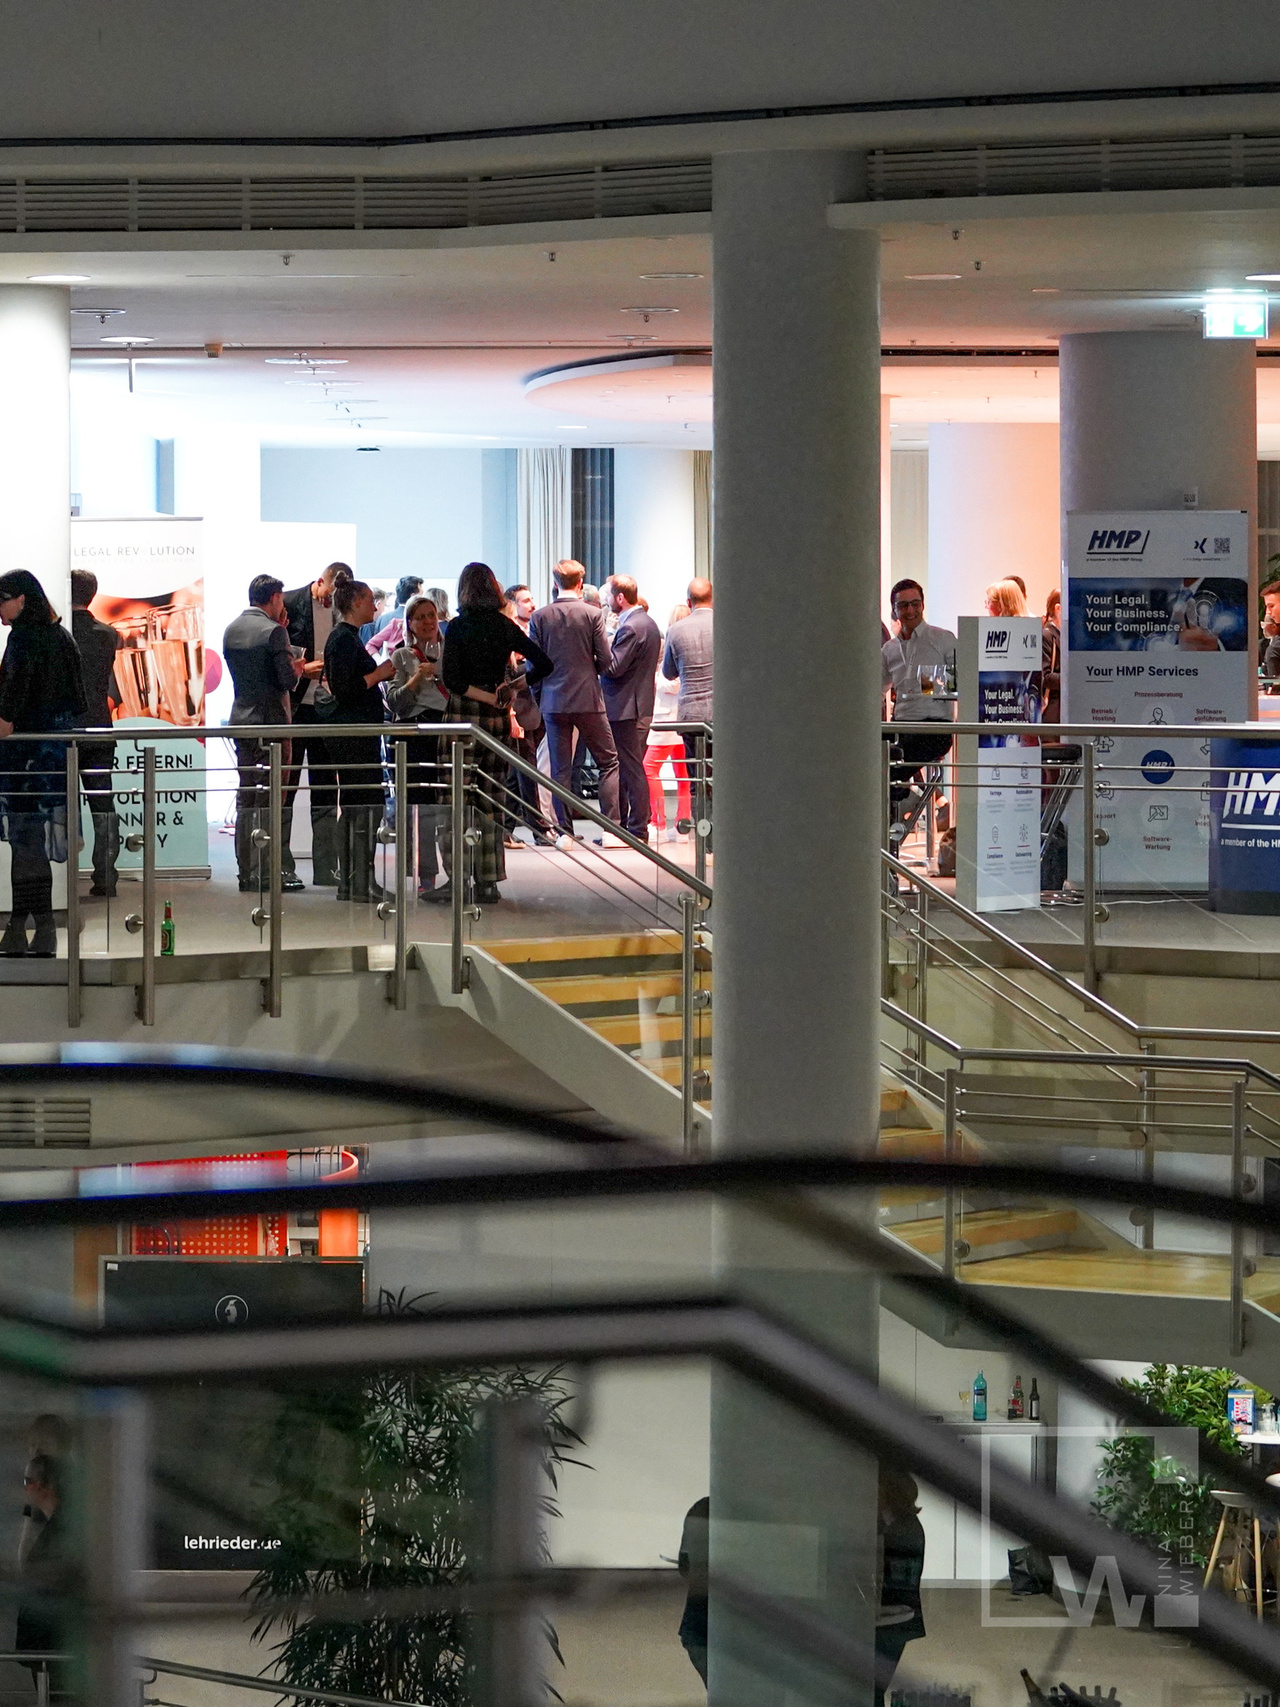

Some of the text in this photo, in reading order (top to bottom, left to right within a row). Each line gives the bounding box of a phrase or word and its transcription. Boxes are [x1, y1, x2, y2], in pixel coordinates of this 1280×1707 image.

[1087, 530, 1143, 551] HMP
[73, 545, 195, 557] LEGAL REVLUTION
[1085, 594, 1149, 607] Your Legal.
[1085, 608, 1169, 619] Your Business.
[1085, 621, 1183, 634] Your Compliance.
[985, 630, 1008, 649] HMP
[1086, 666, 1199, 677] Your HMP Services
[984, 689, 1014, 701] Your Legal.
[1134, 691, 1183, 699] Prozessberatung
[984, 704, 1024, 714] Your Business.
[1092, 715, 1116, 723] Hosting
[126, 754, 194, 769] FEERN!
[1222, 772, 1280, 819] HM
[172, 811, 184, 826] &
[1145, 843, 1171, 851] Wartung
[1225, 838, 1246, 846] member
[1247, 838, 1255, 847] of
[1256, 838, 1270, 848] the
[184, 1535, 282, 1550] lehrieder.de
